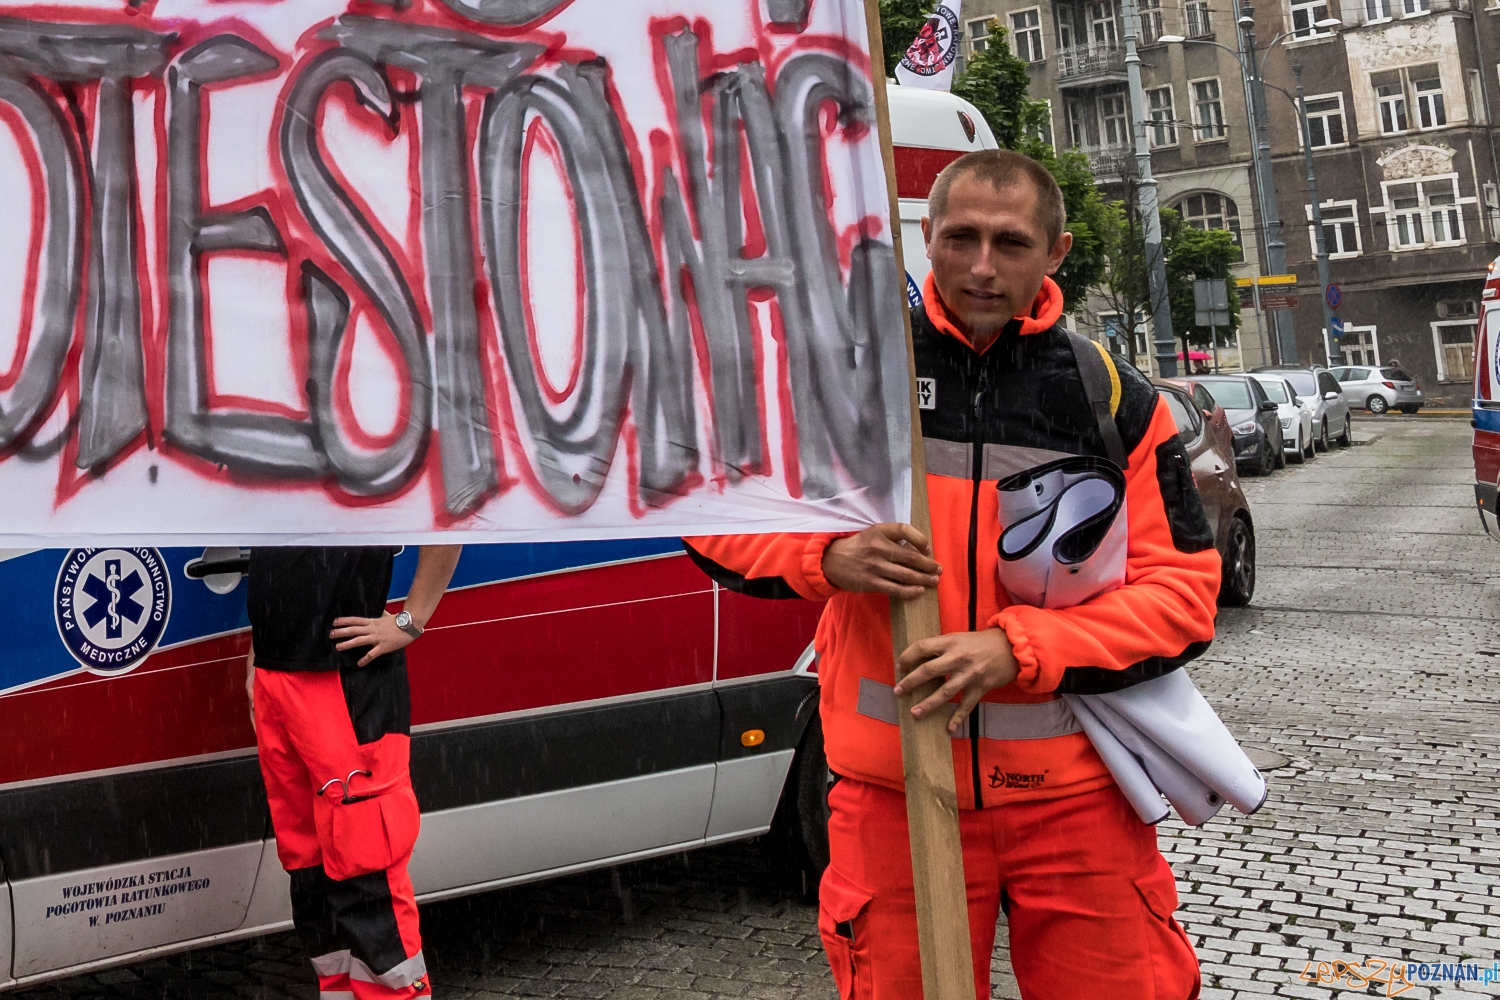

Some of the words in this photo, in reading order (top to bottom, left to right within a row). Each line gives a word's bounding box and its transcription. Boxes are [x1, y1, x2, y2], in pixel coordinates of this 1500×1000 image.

[60, 547, 100, 630] PAŃSTWOW
[132, 547, 165, 622] TOWNICTWO
[80, 636, 148, 662] MEDYCZNE
[45, 895, 118, 918] POGOTOWIA
[120, 877, 211, 904] RATUNKOWEGO
[62, 875, 146, 899] WOJEWÓDZKA
[148, 866, 192, 885] STACJA
[105, 903, 167, 925] POZNANIU
